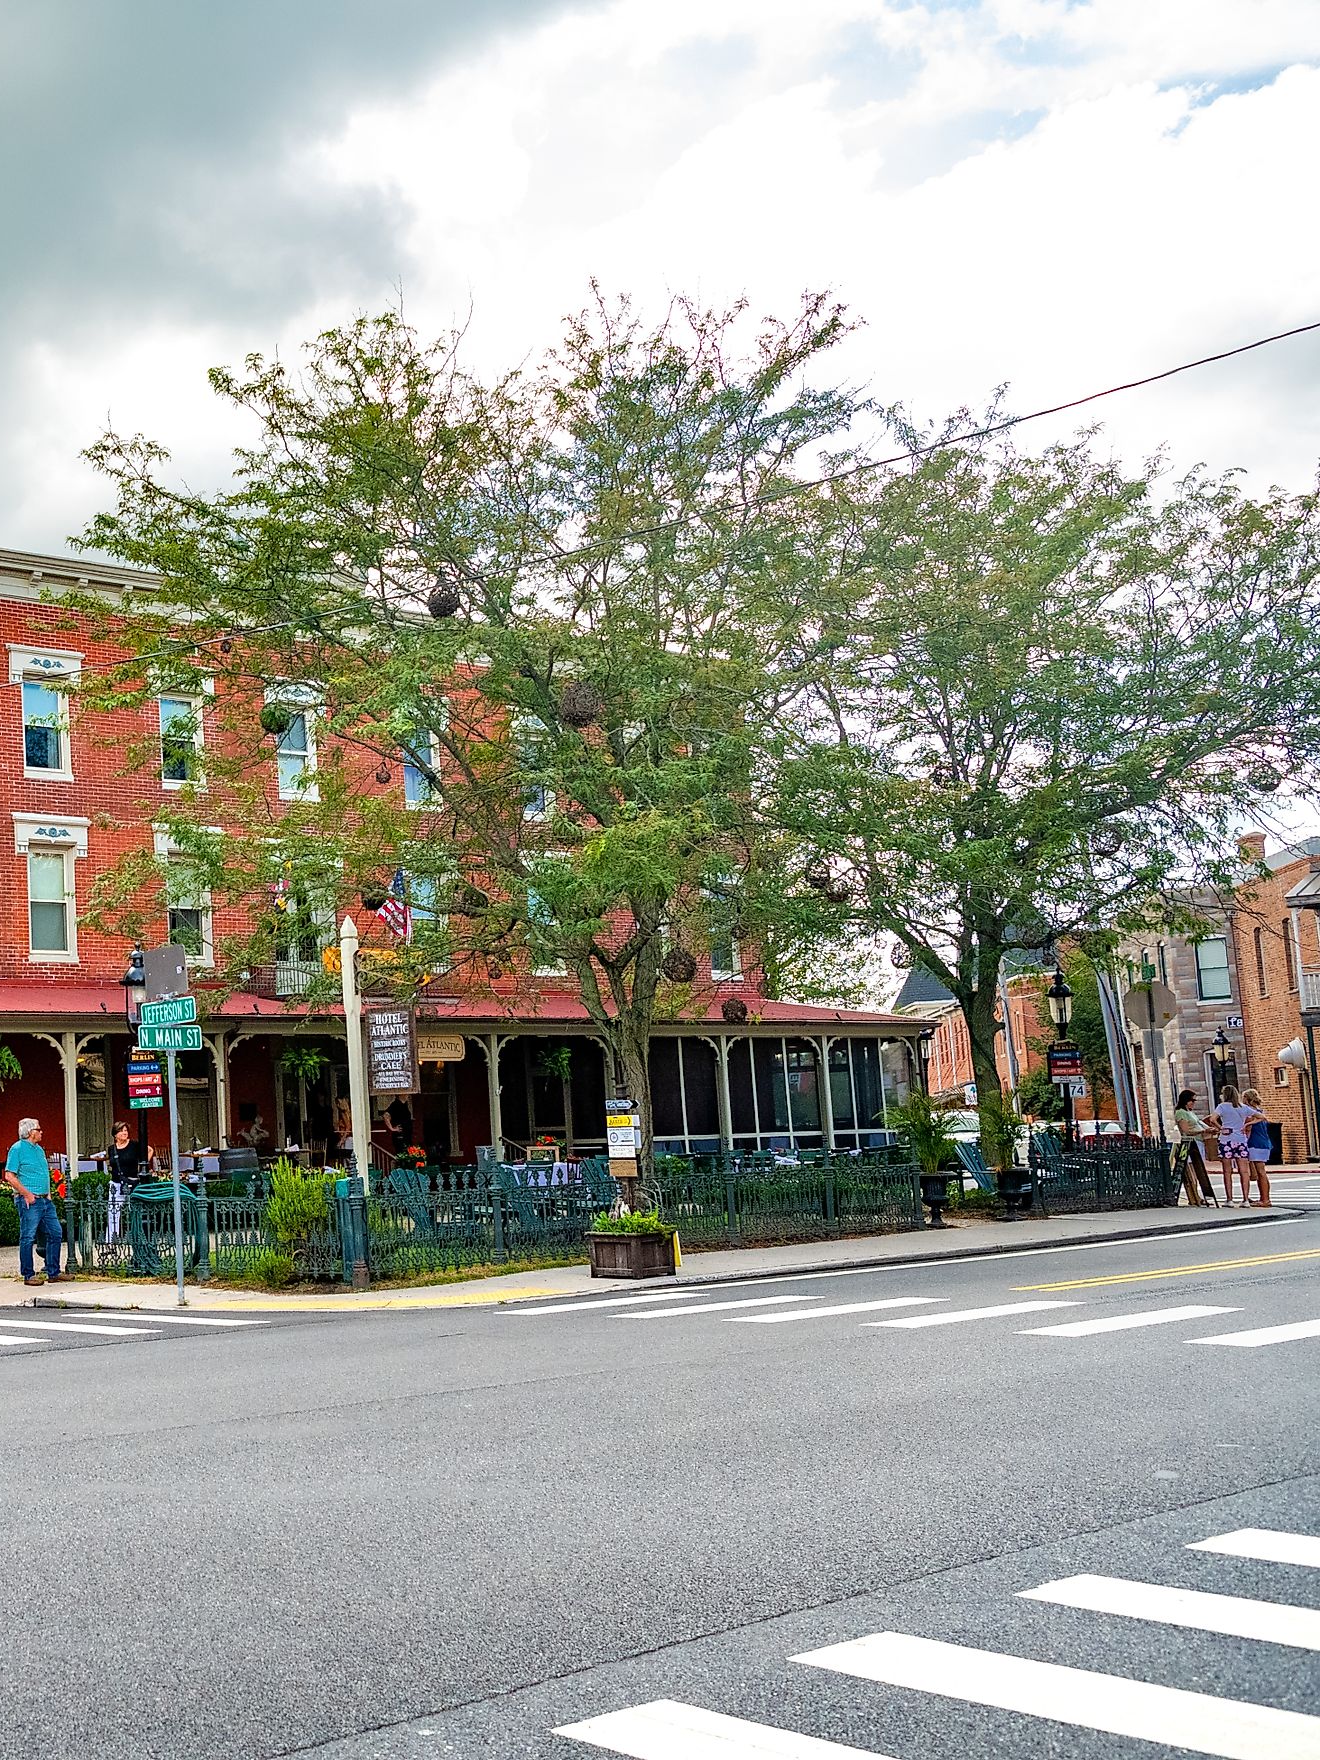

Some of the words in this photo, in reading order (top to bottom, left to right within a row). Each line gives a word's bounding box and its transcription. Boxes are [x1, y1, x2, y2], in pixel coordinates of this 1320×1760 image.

[143, 1002, 183, 1025] JEFFERSON
[184, 1000, 193, 1019] ST
[375, 1012, 403, 1025] HOTEL
[371, 1023, 409, 1037] ATLANTIC
[140, 1029, 152, 1047] N.
[155, 1028, 183, 1047] MAIN
[186, 1029, 199, 1047] ST
[426, 1040, 461, 1053] ATLANTIC
[131, 1053, 155, 1061] BERLIN
[1070, 1085, 1084, 1096] 74
